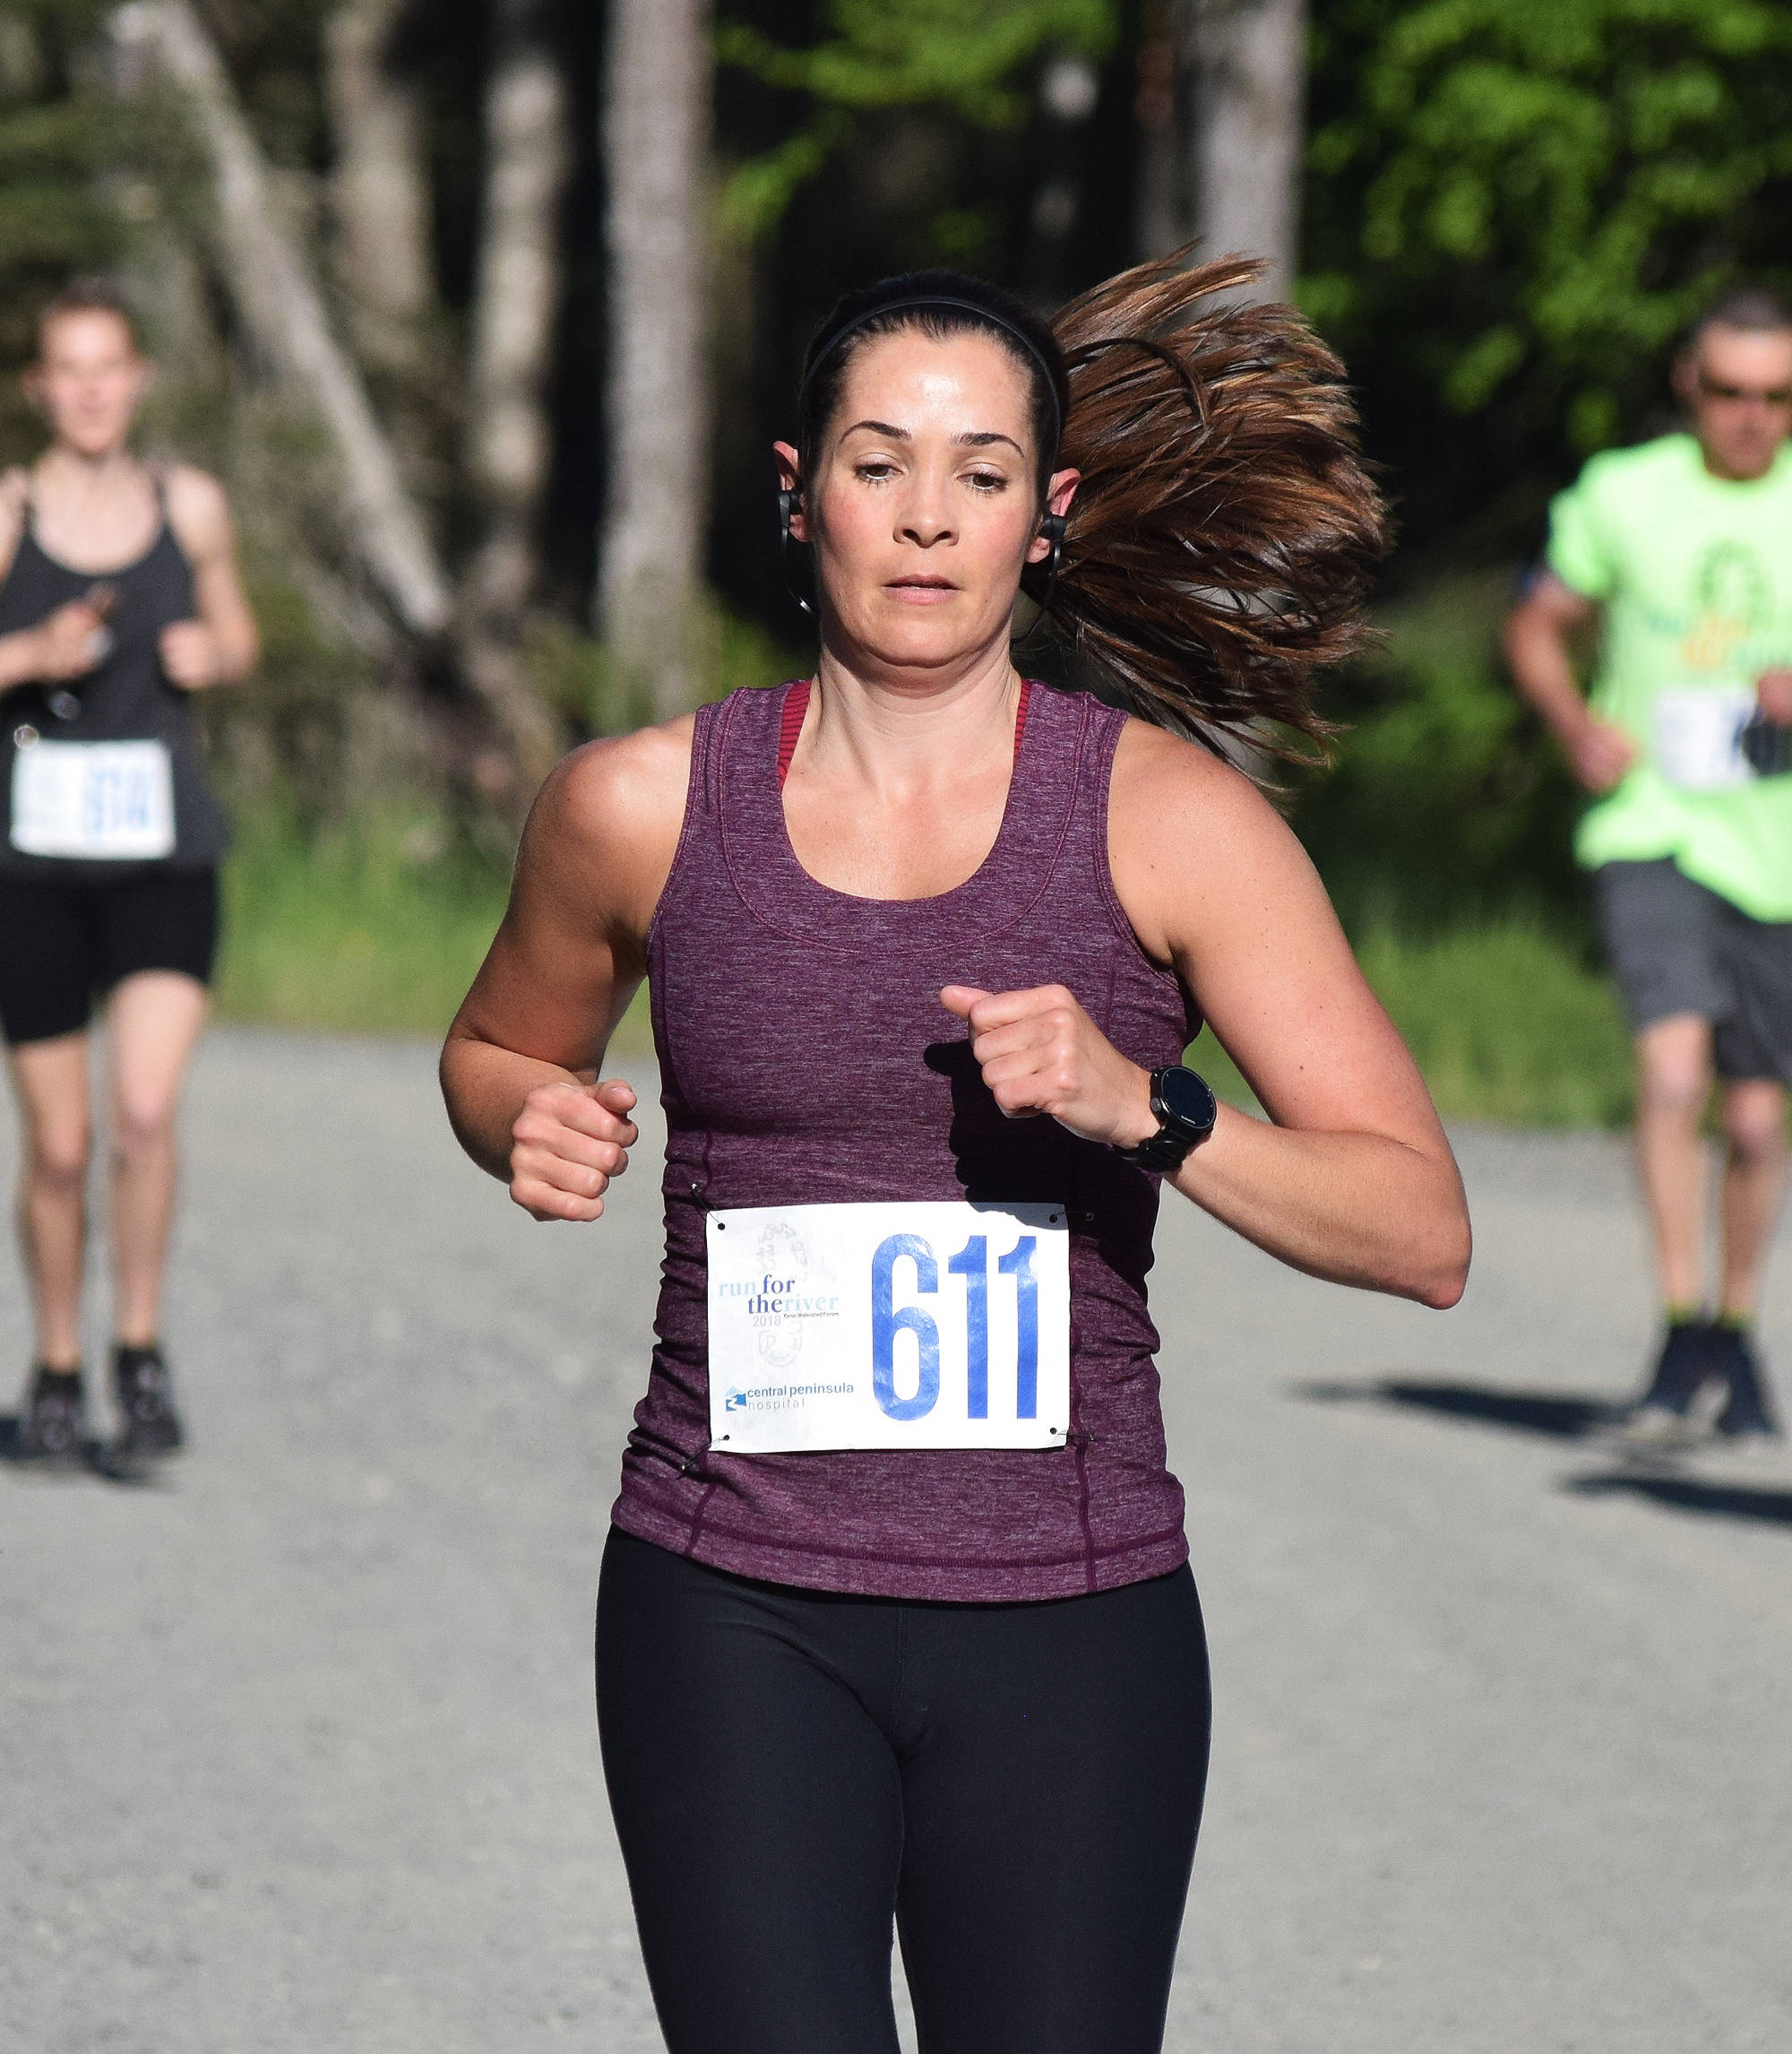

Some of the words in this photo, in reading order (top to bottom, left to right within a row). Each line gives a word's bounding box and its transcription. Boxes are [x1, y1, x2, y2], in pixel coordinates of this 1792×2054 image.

[719, 1282, 756, 1297] run
[763, 1273, 796, 1294] for
[748, 1294, 782, 1314] the
[784, 1293, 839, 1311] river
[753, 1315, 781, 1327] 2018
[872, 1234, 1038, 1420] 611
[747, 1385, 787, 1398] central
[790, 1382, 854, 1397] peninsula
[748, 1398, 805, 1411] hospital
